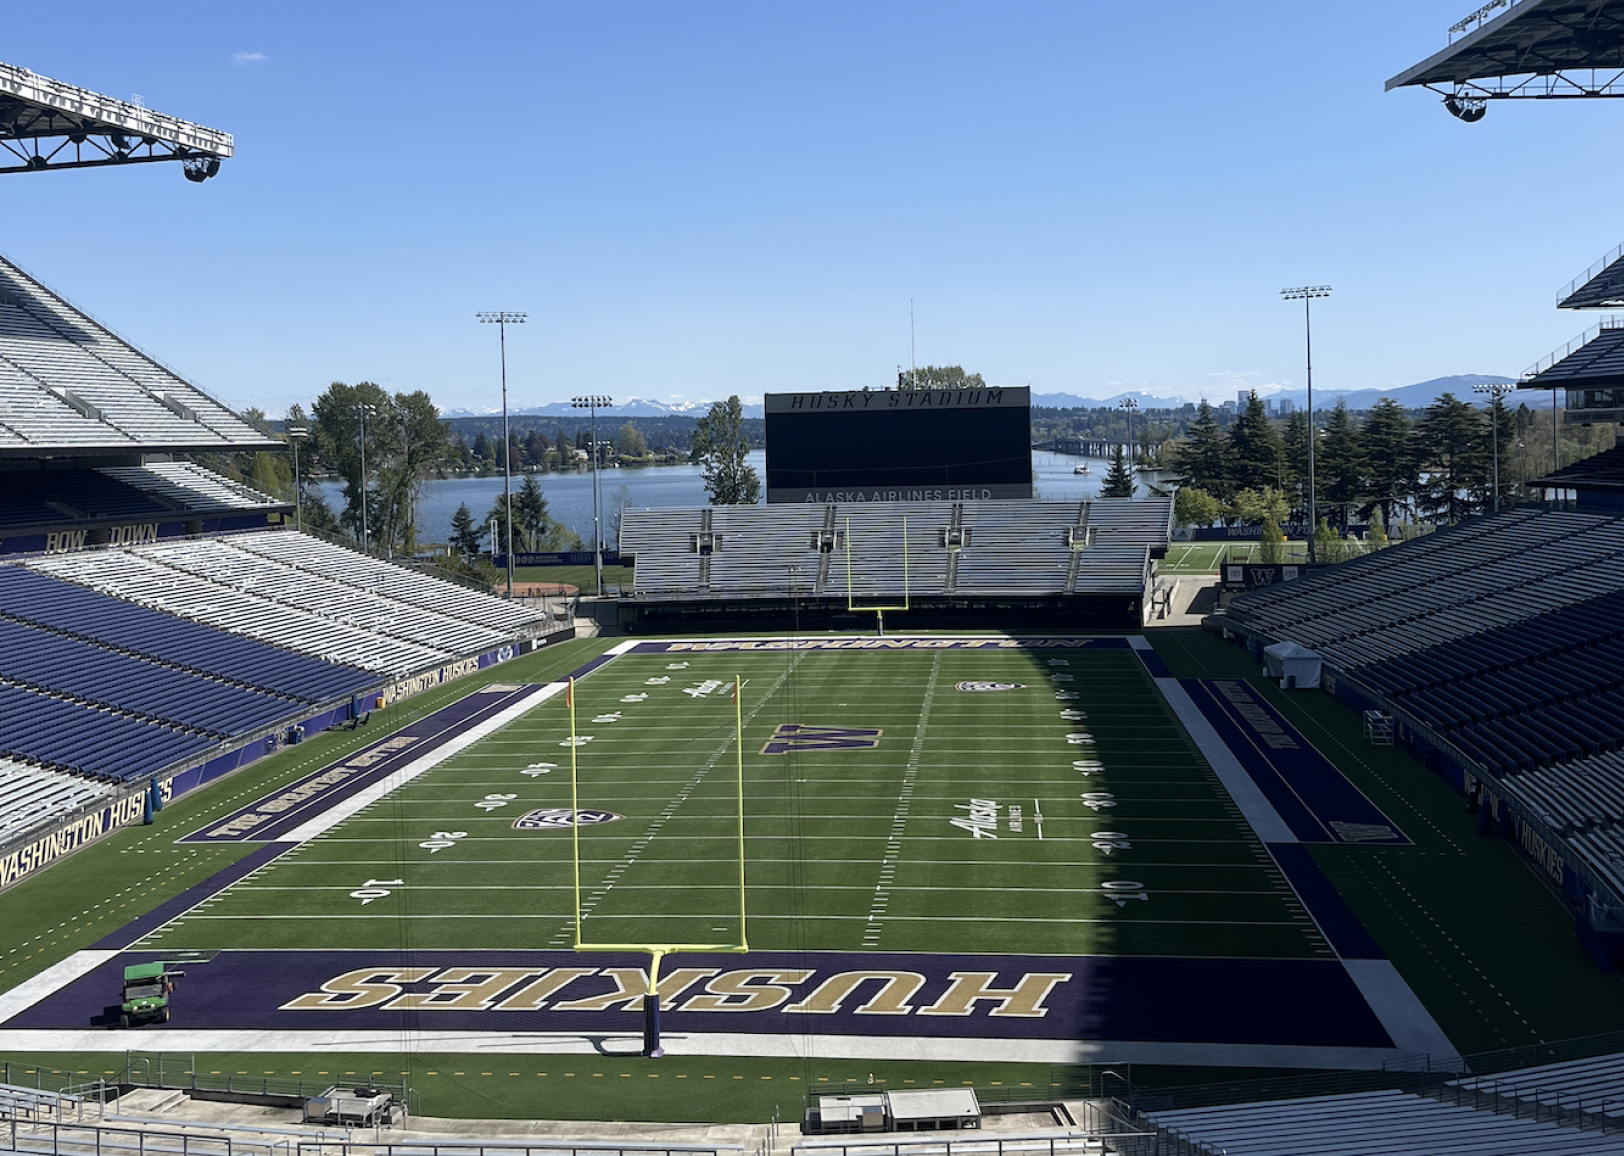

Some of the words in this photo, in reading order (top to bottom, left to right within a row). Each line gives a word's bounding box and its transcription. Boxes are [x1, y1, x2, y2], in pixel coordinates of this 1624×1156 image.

[790, 394, 874, 410] HUSKY
[888, 390, 1003, 408] STADIUM
[805, 492, 866, 503] ALASKA
[872, 490, 942, 502] AIRLINES
[949, 489, 991, 501] FIELD
[45, 530, 89, 554] BOW
[109, 524, 159, 548] DOWN
[1250, 569, 1275, 586] W
[666, 639, 1093, 652] WASHINGTON
[382, 670, 441, 704] WASHINGTON
[441, 656, 480, 683] HUSKIES
[108, 777, 173, 831] HUSKES
[474, 793, 518, 809] 30
[206, 813, 272, 837] THE
[950, 798, 1003, 839] Alaska
[419, 831, 468, 850] 20
[1090, 831, 1131, 850] 20
[1521, 819, 1564, 886] HUSKIES
[350, 879, 404, 900] 10
[1101, 880, 1149, 901] 10
[278, 966, 1073, 1018] HUSKIES
